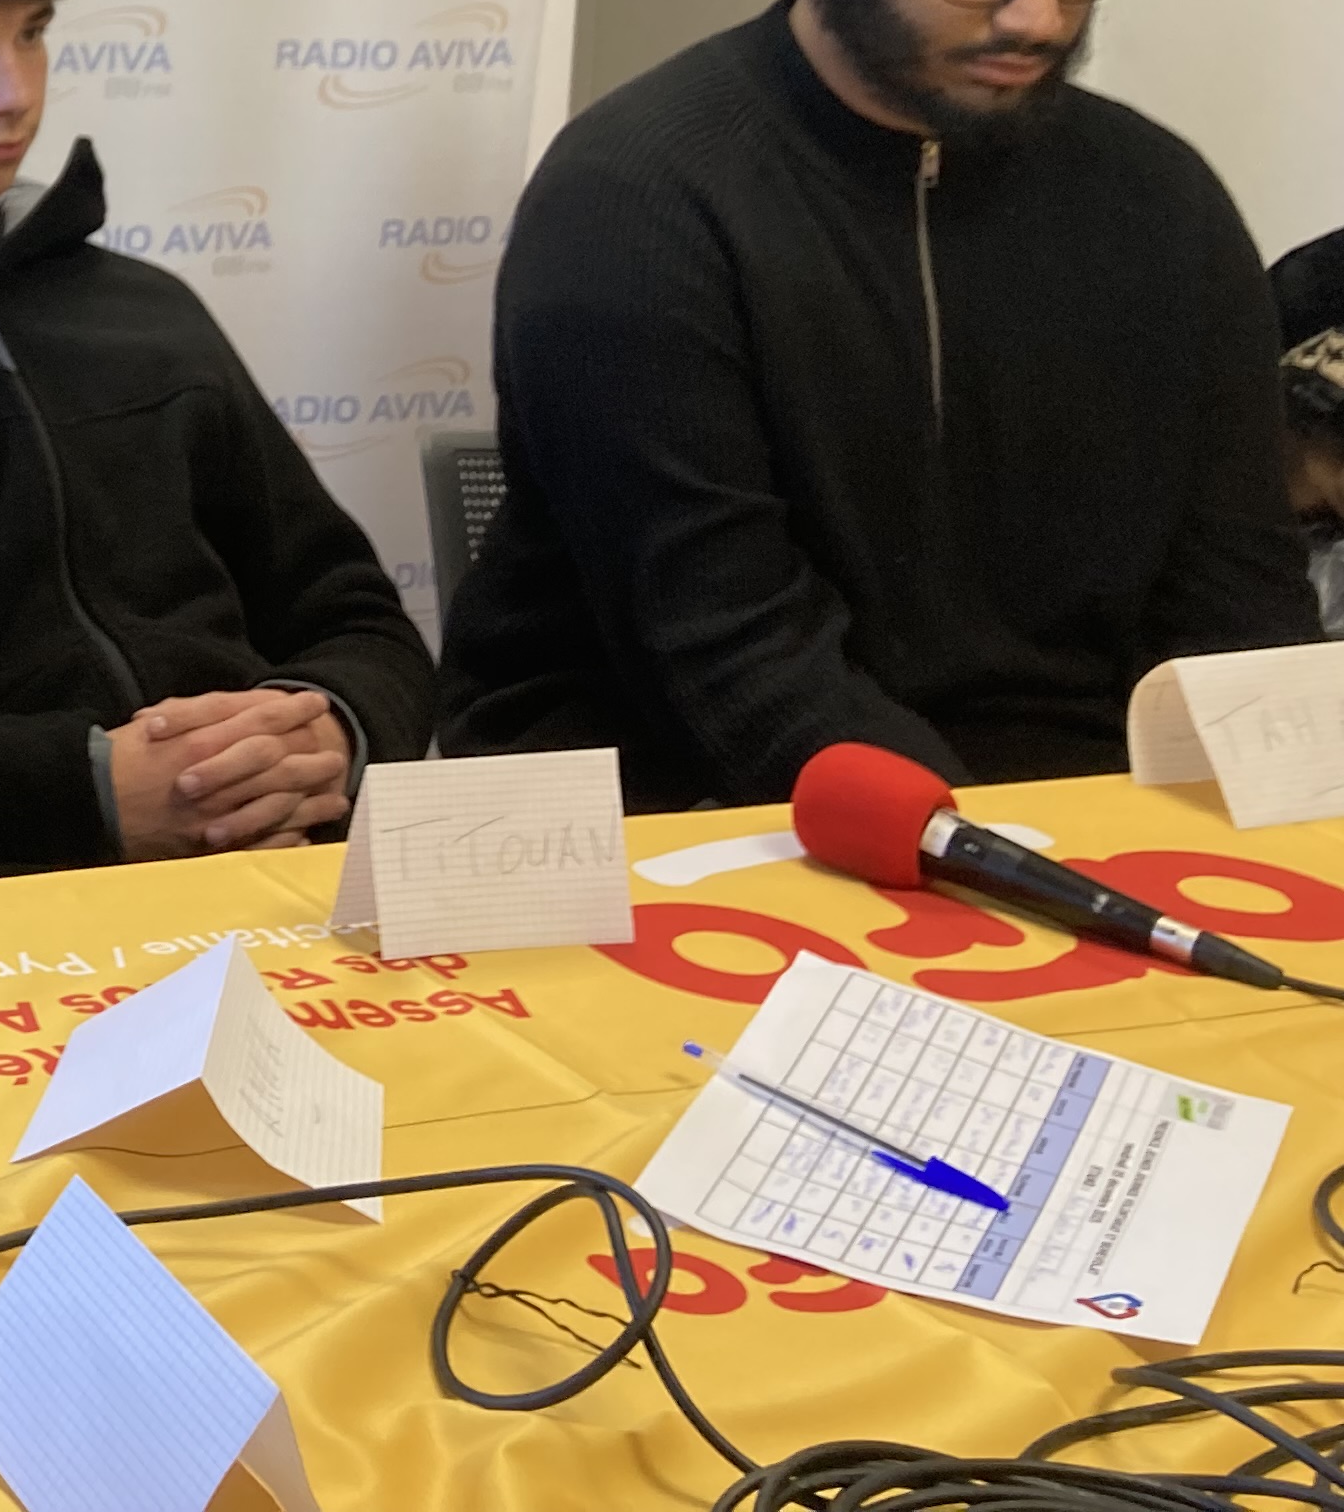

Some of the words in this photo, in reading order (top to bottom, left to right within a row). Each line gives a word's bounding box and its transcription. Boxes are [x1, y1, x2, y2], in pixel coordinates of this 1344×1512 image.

[54, 42, 172, 74] AVIVA
[274, 38, 398, 70] RADIO
[408, 38, 513, 69] AVIVA
[163, 221, 273, 254] AVIVA
[379, 216, 492, 249] RADIO
[273, 394, 361, 425] ADIO
[369, 388, 475, 423] AVIVA
[287, 987, 533, 1031] Assem
